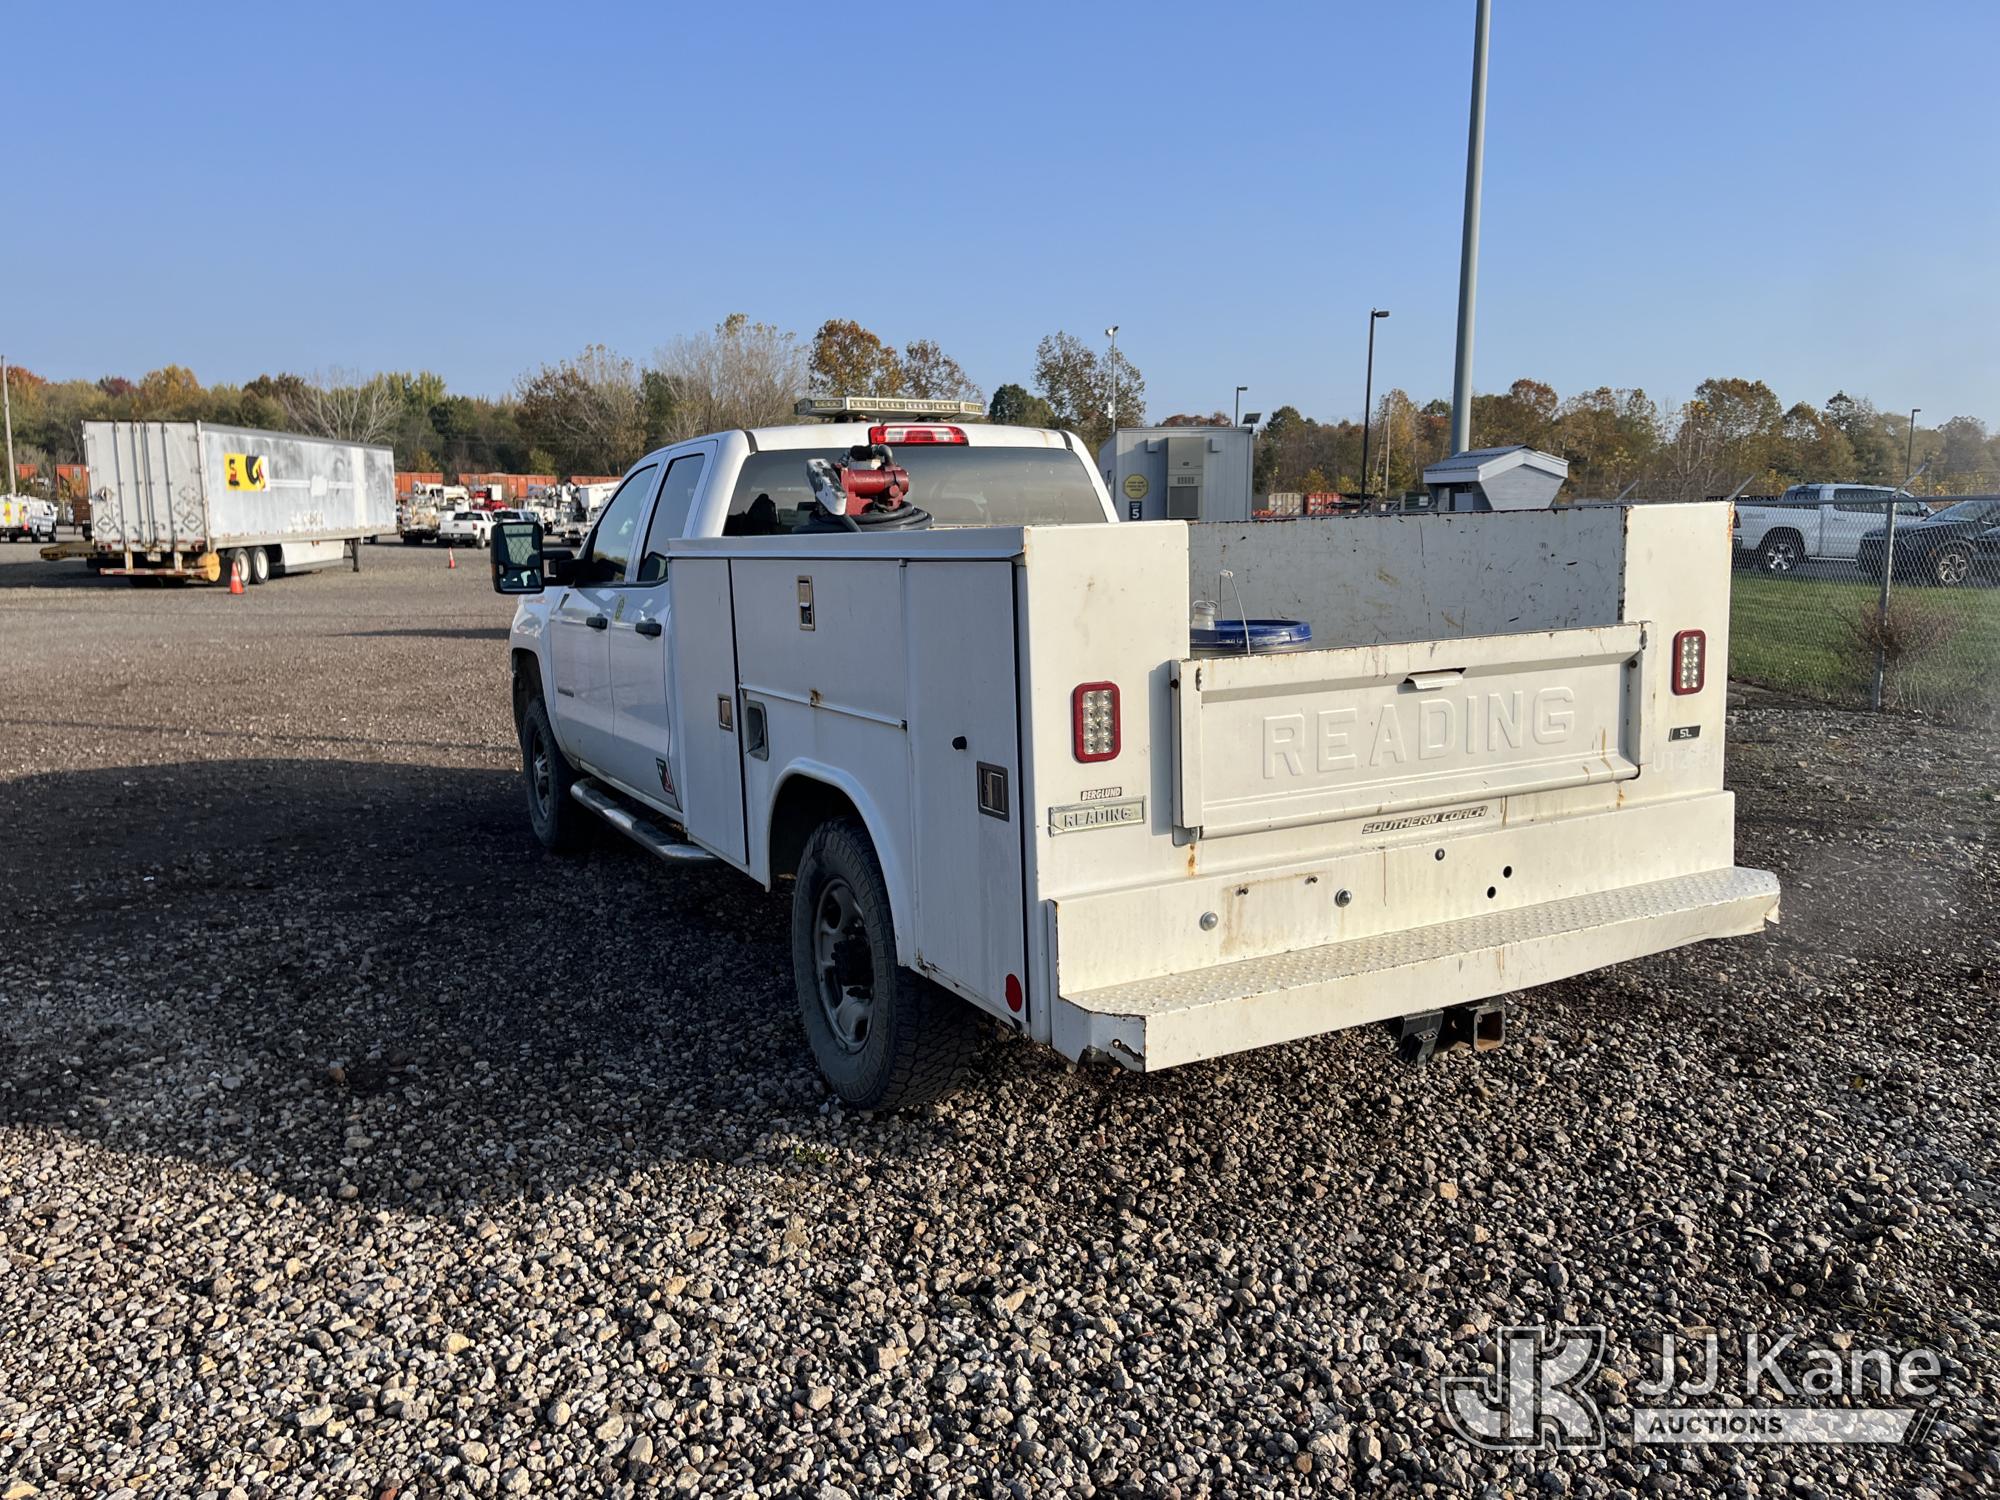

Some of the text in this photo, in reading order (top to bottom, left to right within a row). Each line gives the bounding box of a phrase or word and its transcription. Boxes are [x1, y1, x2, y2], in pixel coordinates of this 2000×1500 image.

[1132, 508, 1140, 519] 5
[1263, 686, 1575, 779] READING
[1679, 728, 1692, 738] SL
[1081, 787, 1121, 800] BERGLUND
[1064, 807, 1131, 827] READING
[1362, 805, 1488, 834] SOUTHERN COACH
